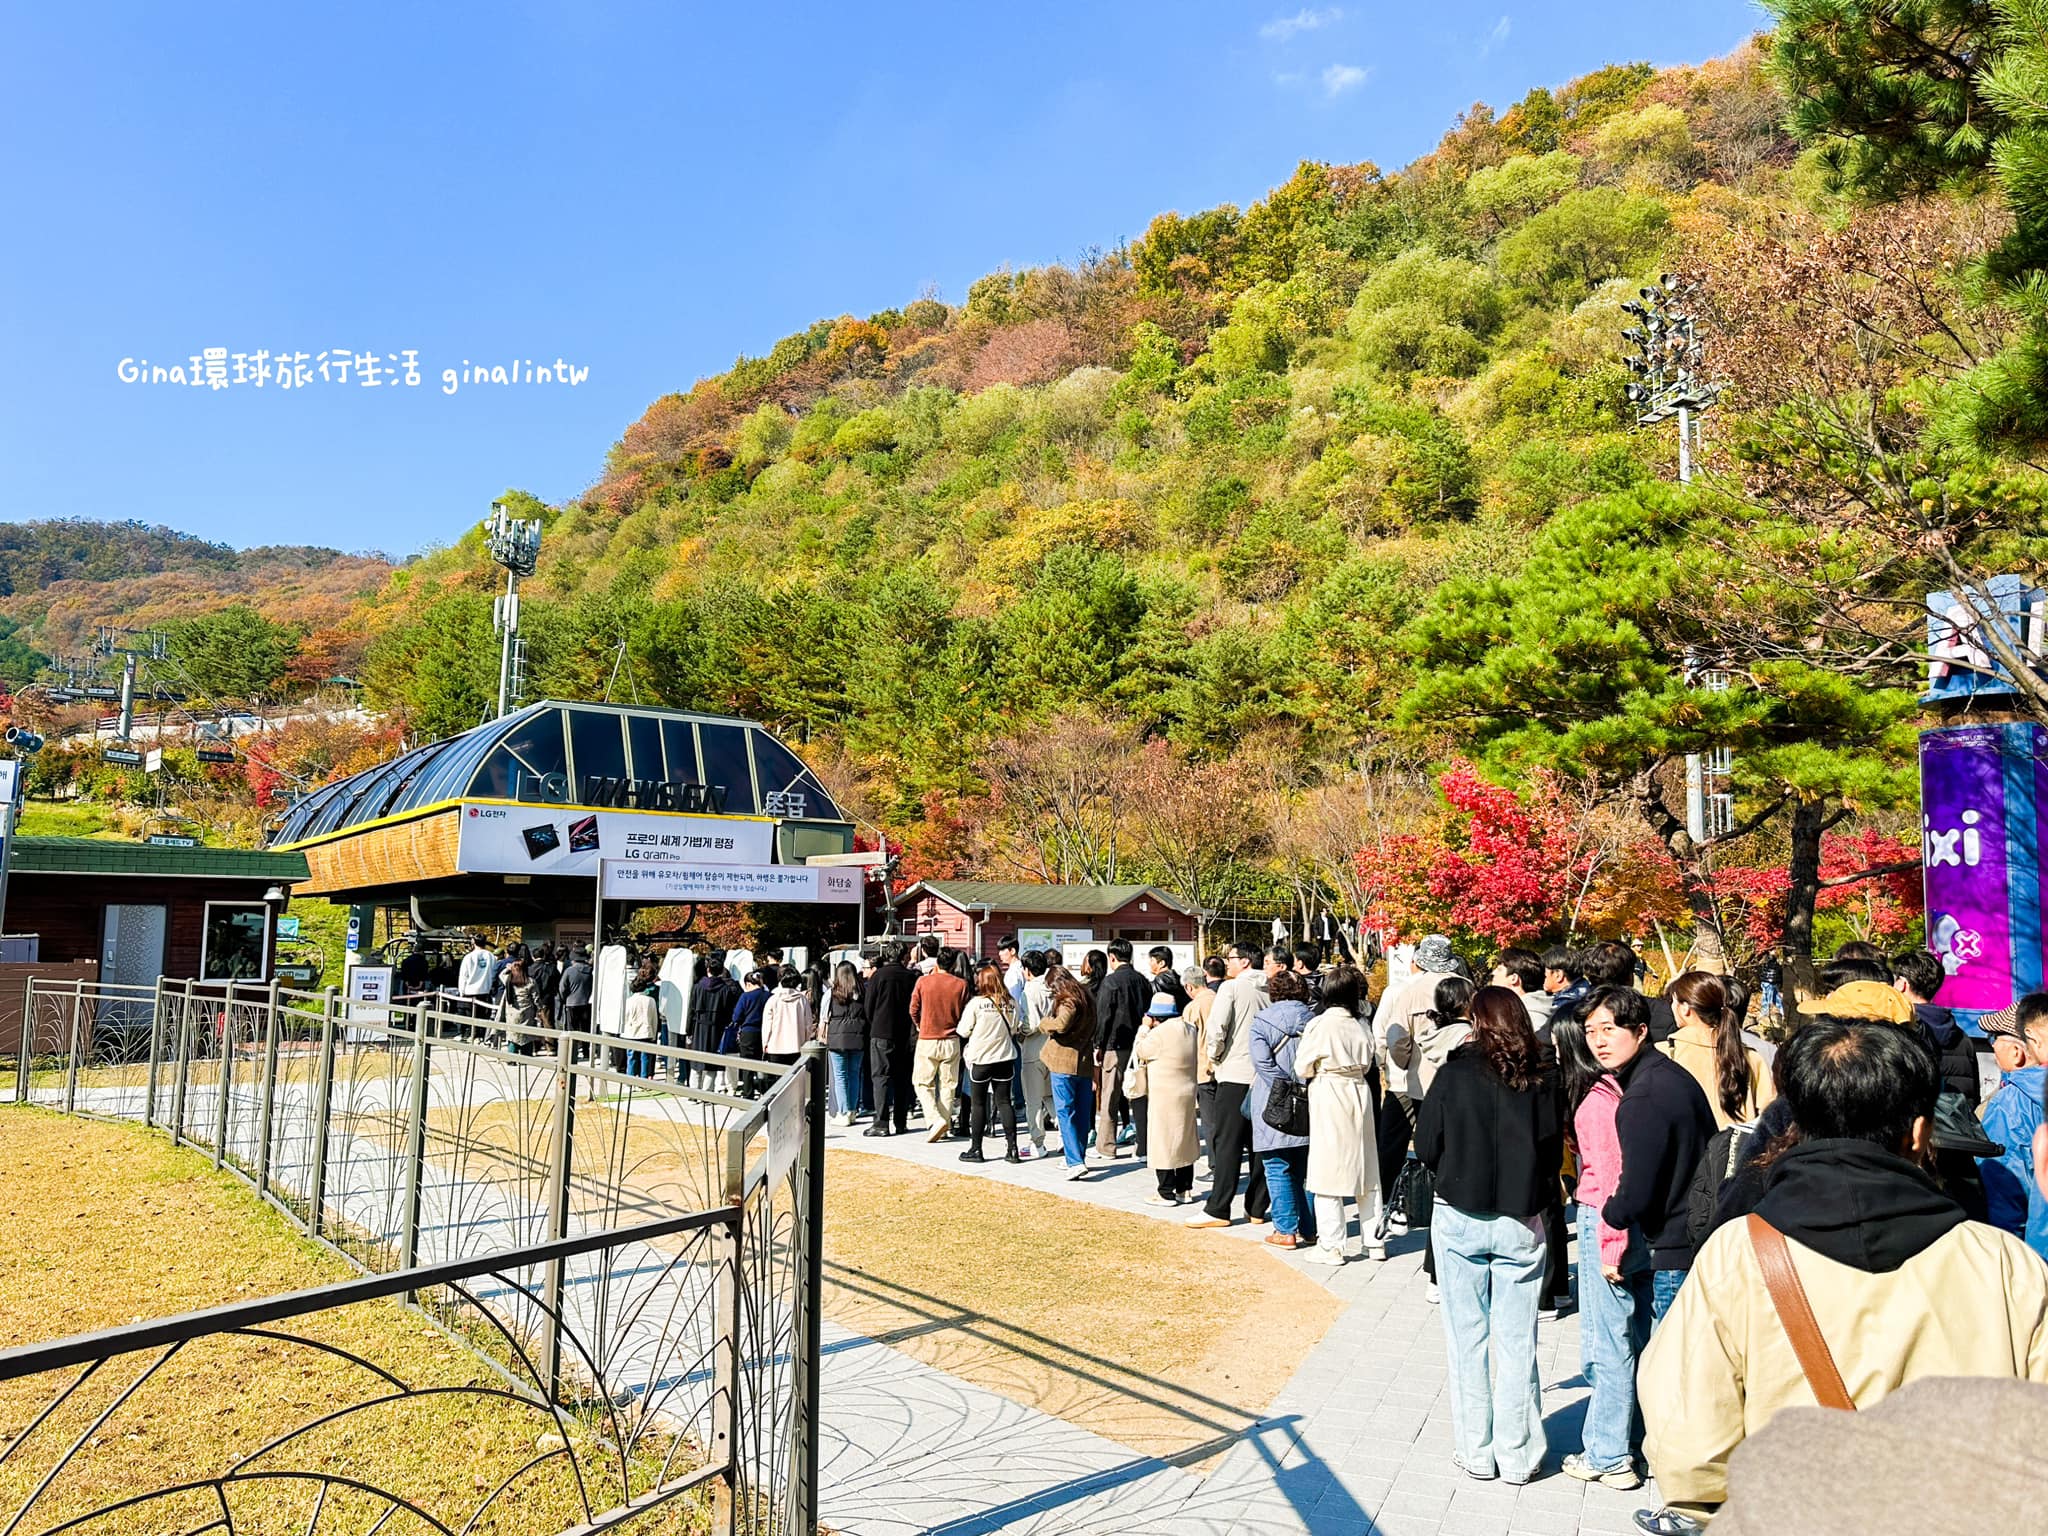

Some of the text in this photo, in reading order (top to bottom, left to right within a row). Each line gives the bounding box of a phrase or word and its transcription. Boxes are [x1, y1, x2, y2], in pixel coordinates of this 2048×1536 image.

[516, 770, 729, 814] LG WHISEN
[626, 833, 734, 850] 프로의 세계 가볍게 평정
[625, 849, 640, 859] LG
[642, 851, 669, 861] gram
[617, 869, 639, 880] 안전을
[641, 870, 656, 880] 위해
[658, 870, 703, 881] 유모차/휠체어
[704, 871, 725, 881] 탑승이
[777, 874, 809, 884] 불가합니다
[827, 876, 852, 888] 화담숲
